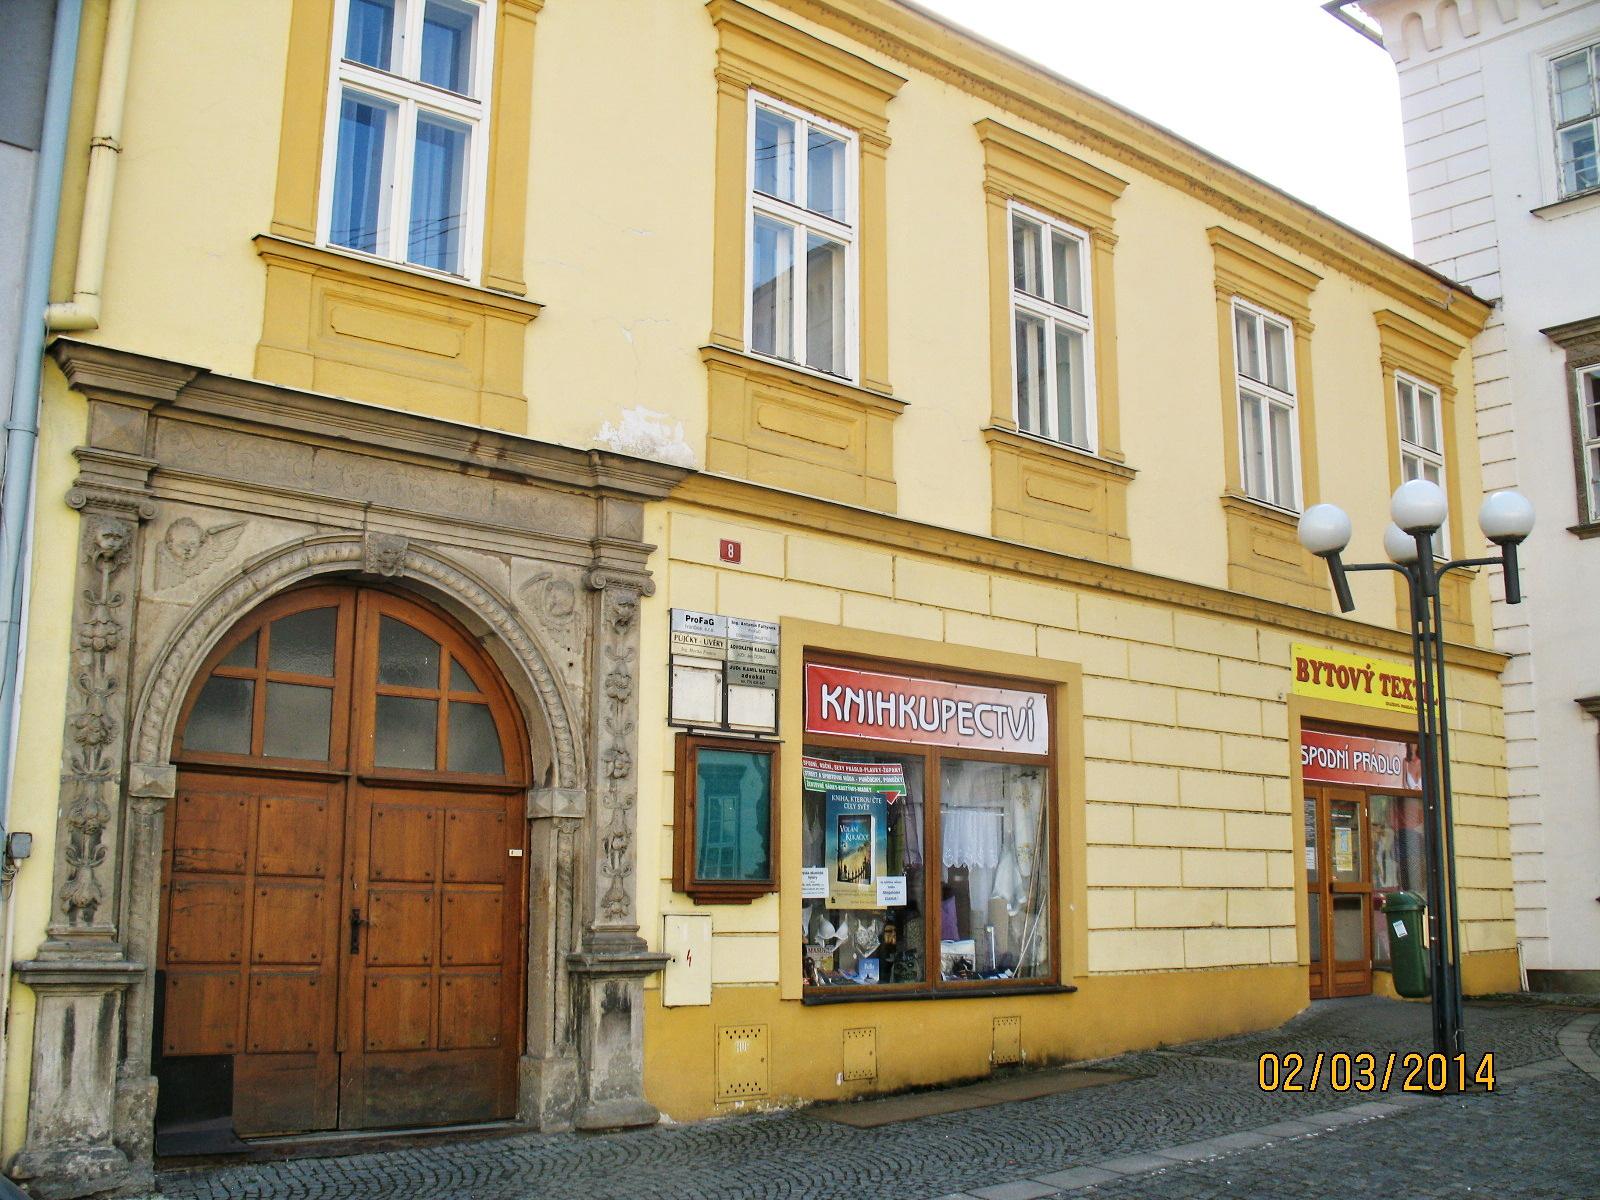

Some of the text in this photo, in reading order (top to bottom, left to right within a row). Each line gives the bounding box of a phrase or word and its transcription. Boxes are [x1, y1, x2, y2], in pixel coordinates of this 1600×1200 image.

[728, 543, 734, 558] 8
[685, 614, 715, 626] ProFaG
[1379, 672, 1439, 706] TEXI
[820, 682, 1036, 743] KNIHKUPECTVÍ
[1301, 744, 1401, 776] SPODNÍ PRÁDLO
